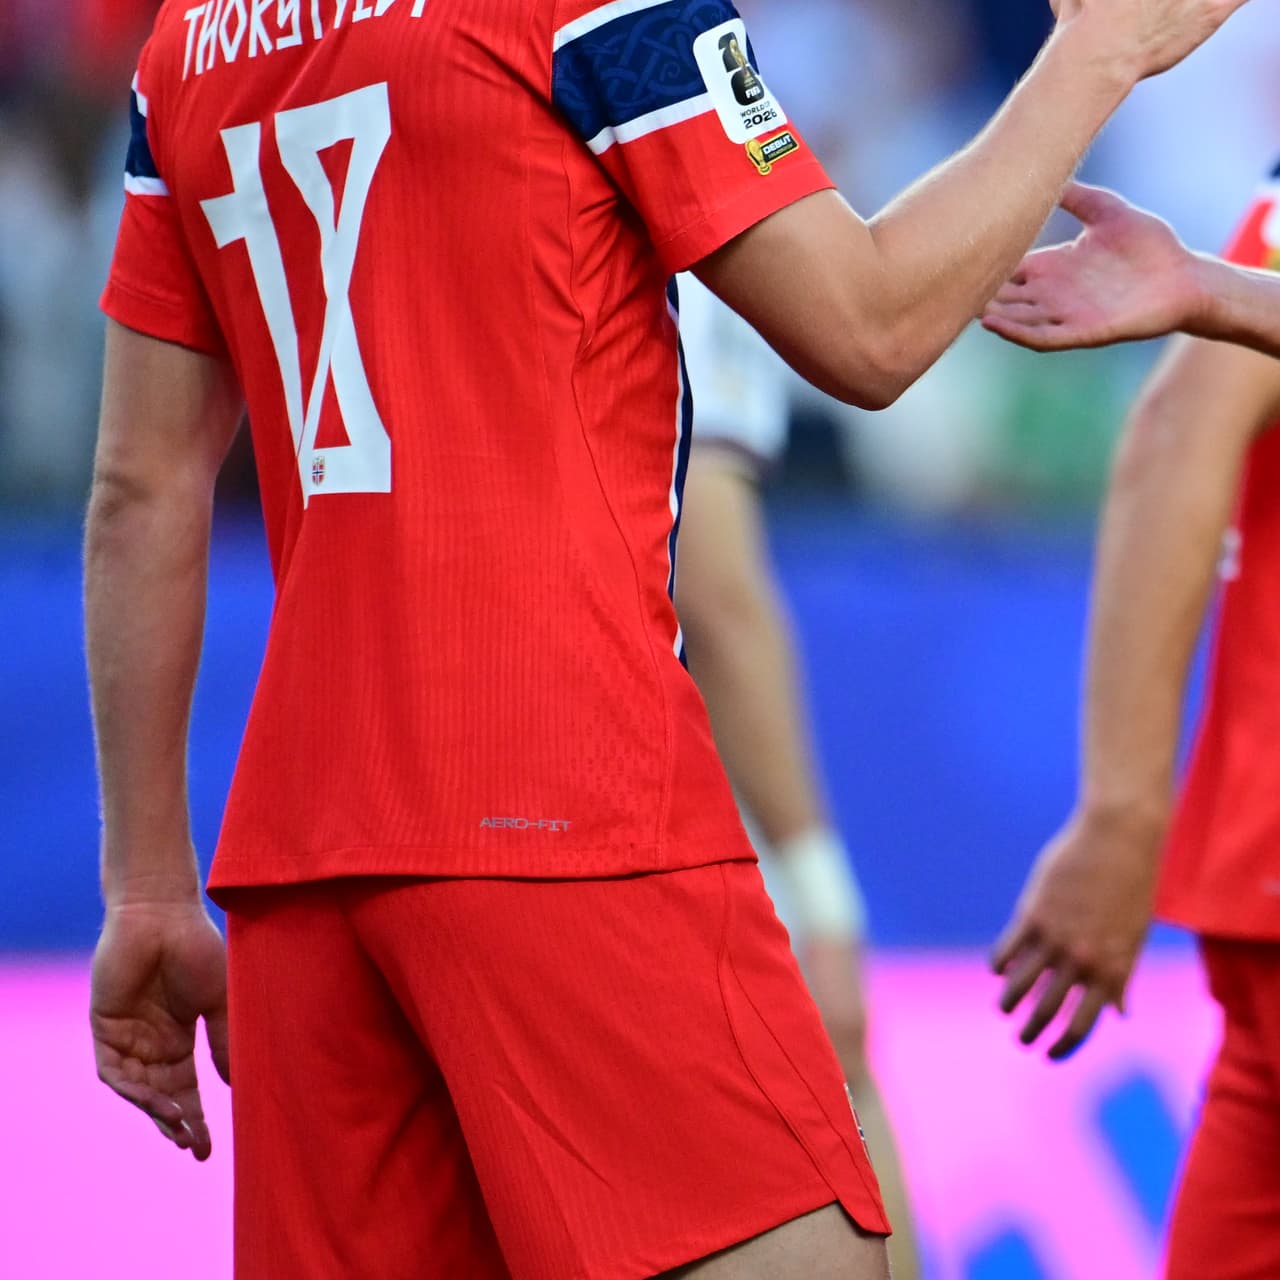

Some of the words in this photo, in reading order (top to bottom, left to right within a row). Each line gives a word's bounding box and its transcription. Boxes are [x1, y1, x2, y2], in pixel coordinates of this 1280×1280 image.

[763, 134, 793, 155] DEBUT
[199, 81, 392, 510] 18
[480, 816, 572, 832] AERO-FIT
